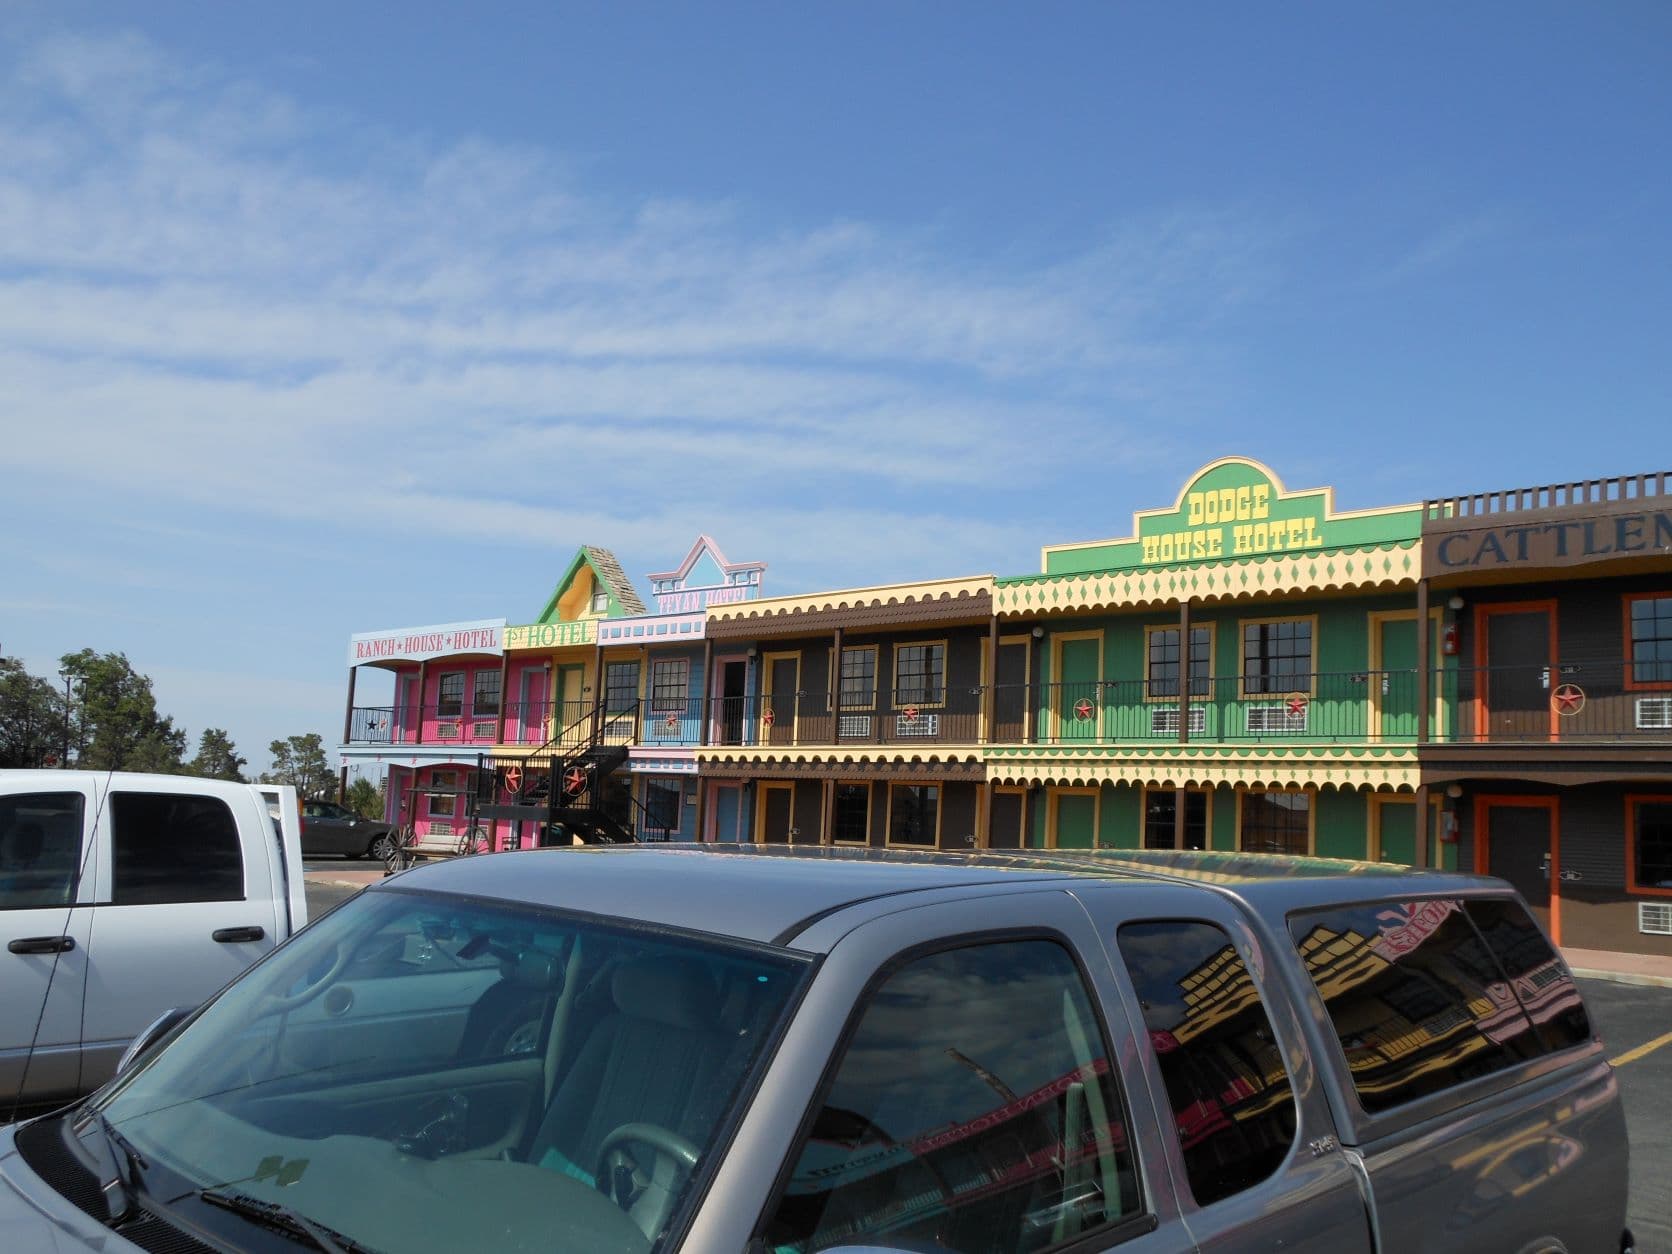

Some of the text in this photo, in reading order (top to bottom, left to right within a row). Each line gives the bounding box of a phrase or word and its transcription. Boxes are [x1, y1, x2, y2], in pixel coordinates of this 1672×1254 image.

[1188, 484, 1269, 526] DODGE
[1142, 517, 1322, 563] HOUSE HOTEL
[658, 591, 700, 615] TEXAN
[356, 629, 496, 658] RANCH HOUSE HOTEL
[527, 623, 592, 647] HOTEL
